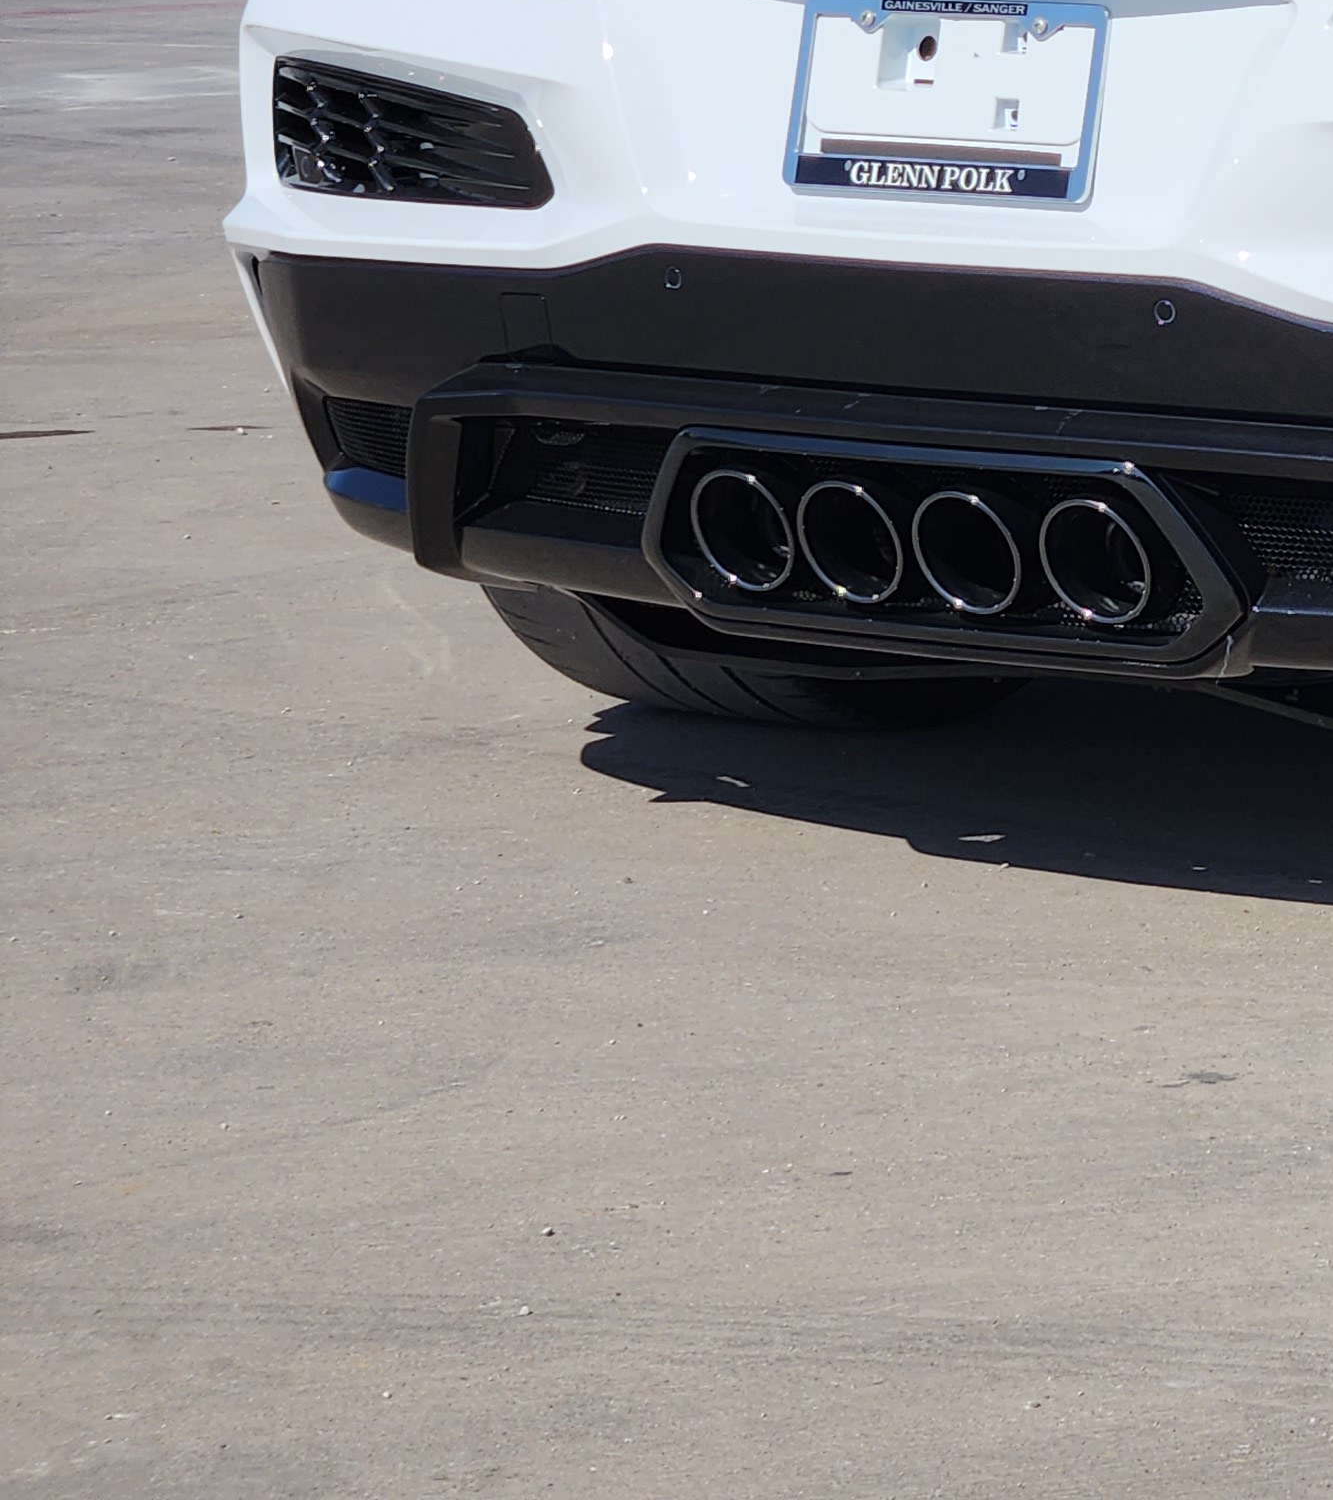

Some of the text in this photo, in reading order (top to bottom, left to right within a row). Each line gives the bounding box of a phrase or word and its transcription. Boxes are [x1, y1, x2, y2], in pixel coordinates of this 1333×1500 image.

[884, 0, 963, 13] GAINESVILLE
[973, 3, 1026, 15] SANGER
[850, 160, 1014, 193] GLENN POLK
